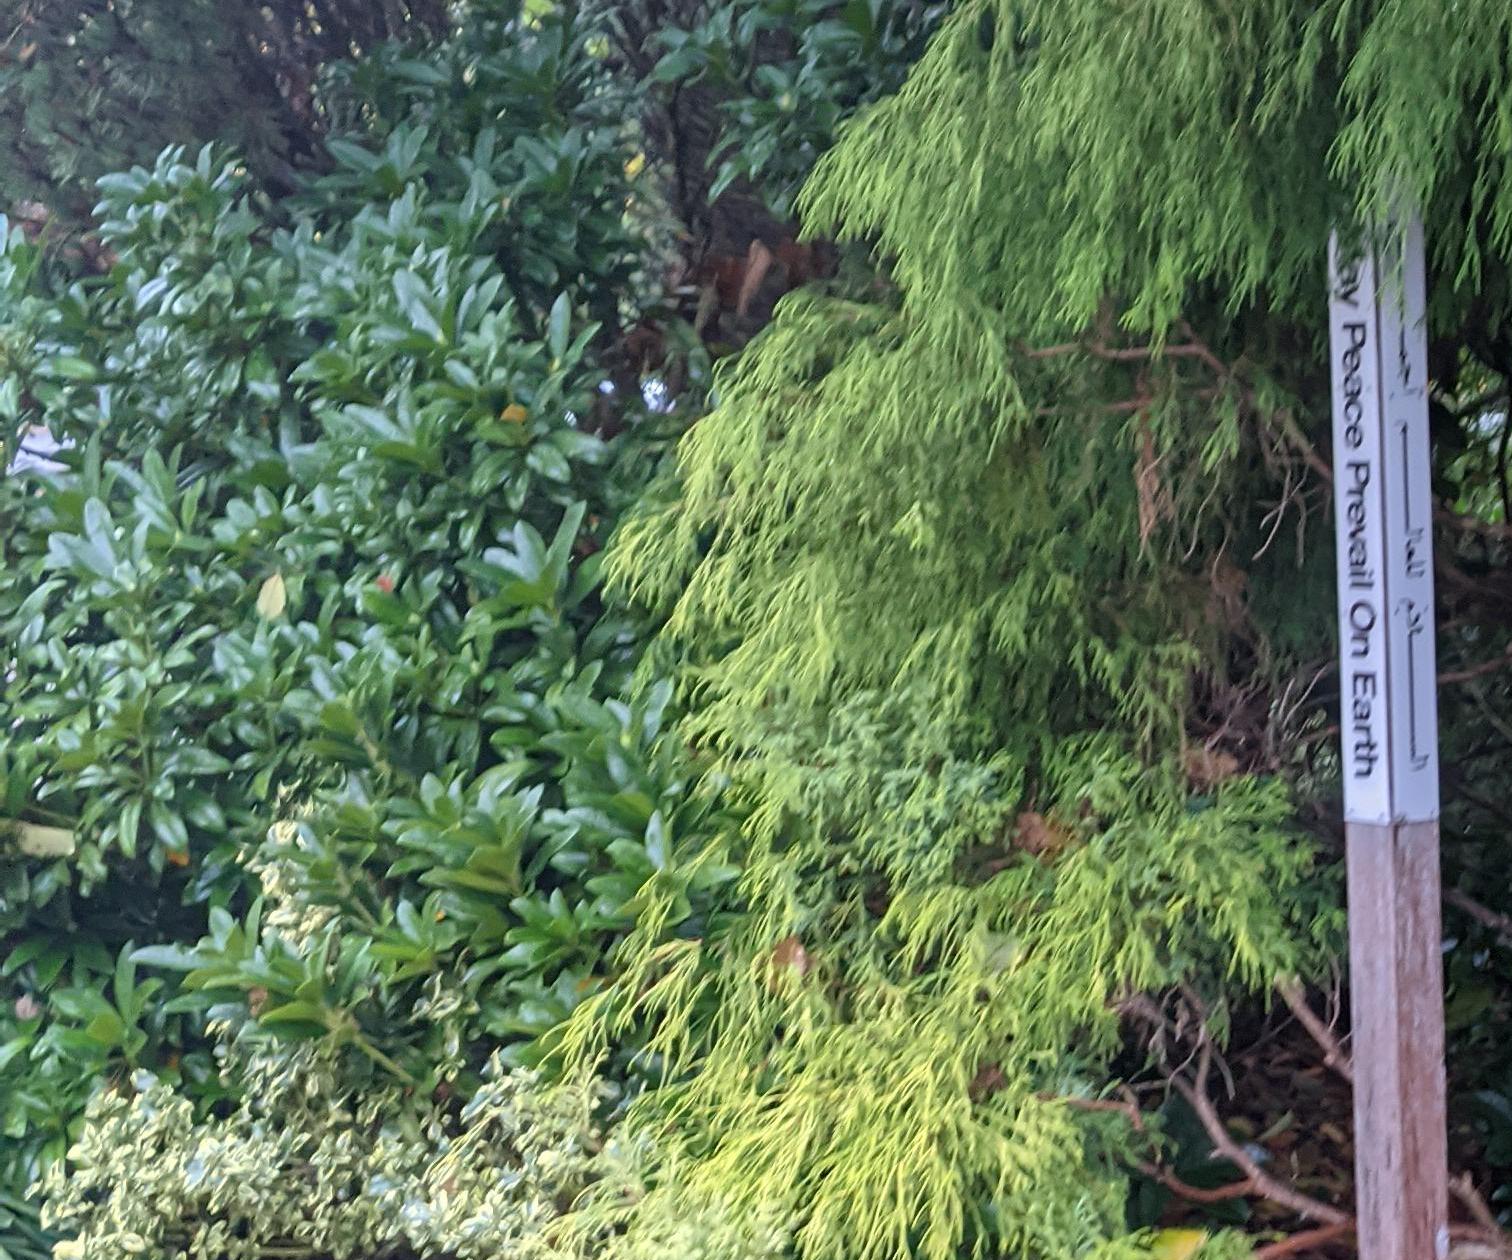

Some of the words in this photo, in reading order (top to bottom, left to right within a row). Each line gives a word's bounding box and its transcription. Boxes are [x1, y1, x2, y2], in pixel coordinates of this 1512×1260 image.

[1341, 323, 1367, 449] Peace
[1345, 461, 1374, 590] Prevail
[1350, 601, 1377, 659] On
[1353, 671, 1379, 778] Earth
